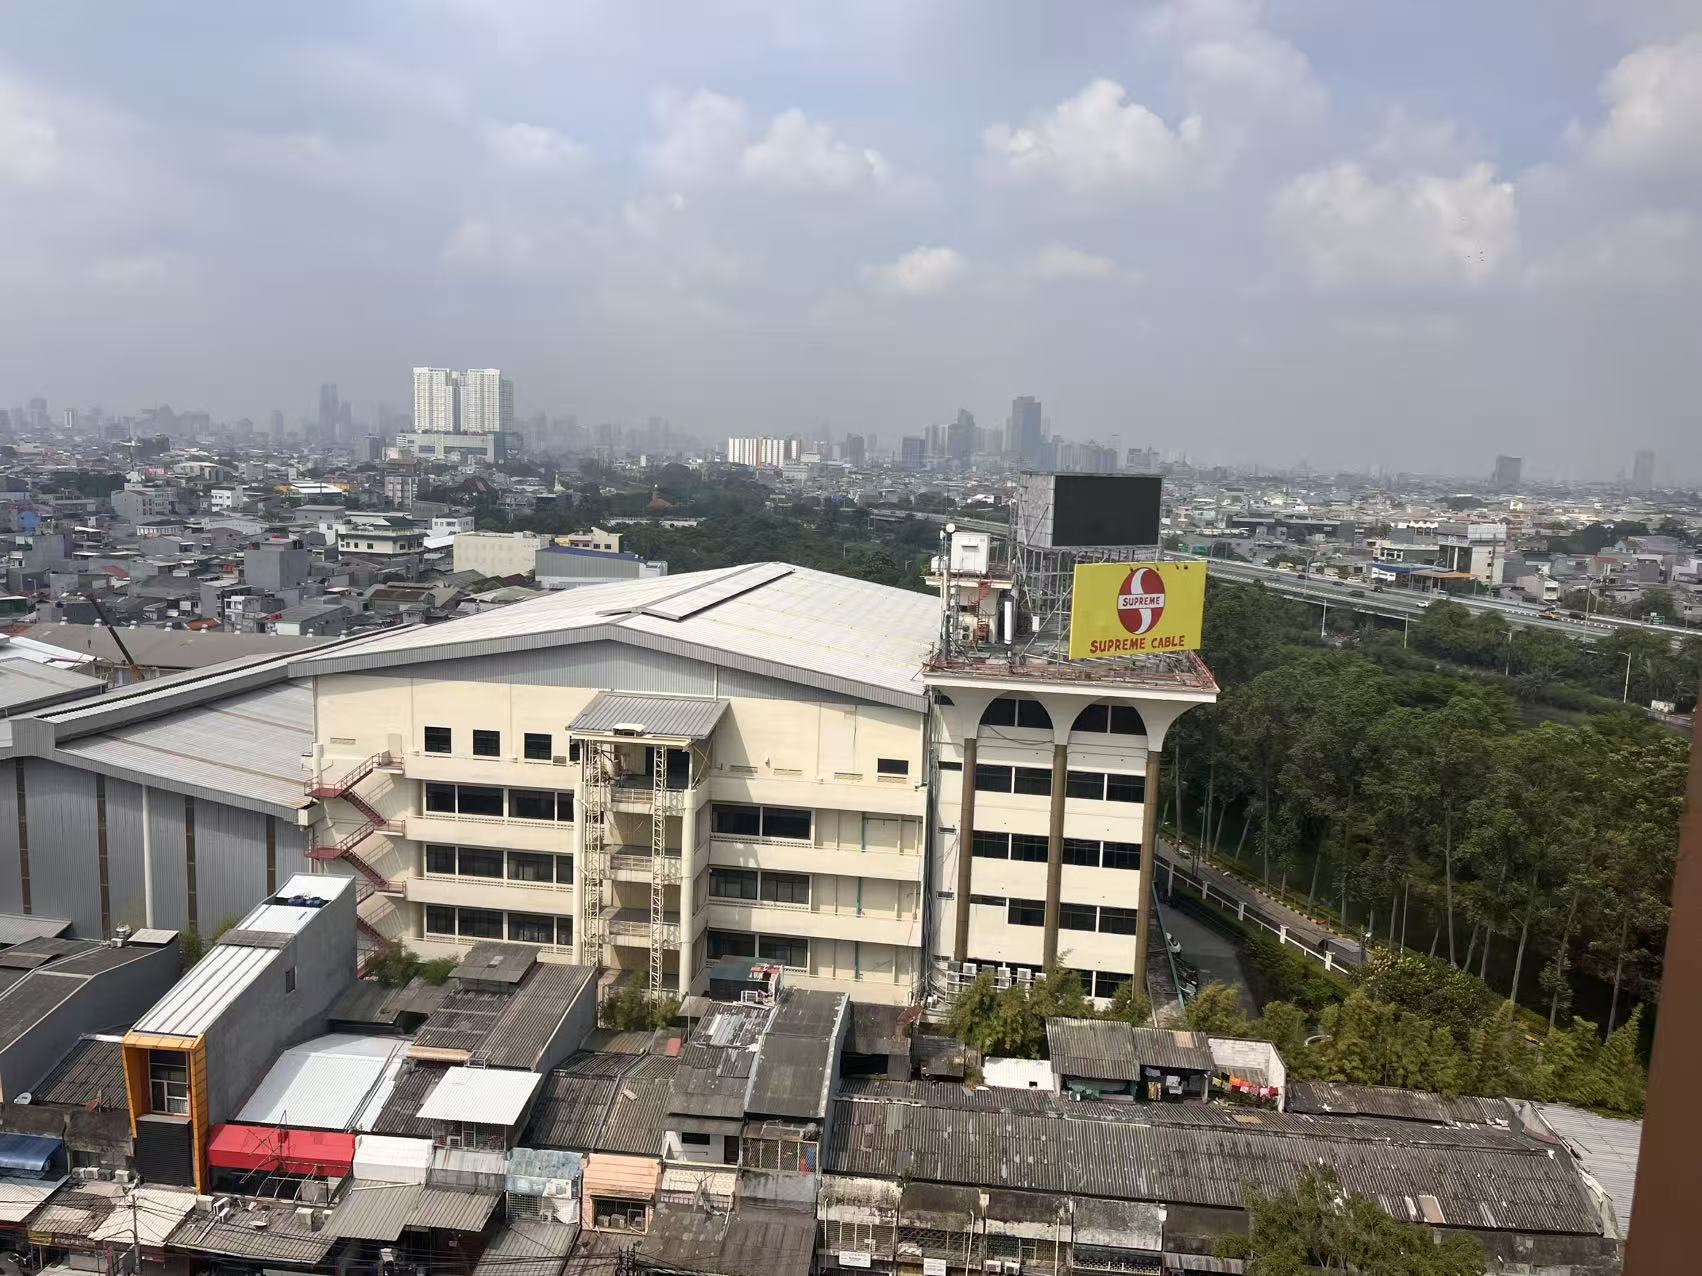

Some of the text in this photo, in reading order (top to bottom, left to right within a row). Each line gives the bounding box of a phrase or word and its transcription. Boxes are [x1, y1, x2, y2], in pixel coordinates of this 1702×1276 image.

[1122, 597, 1160, 607] SUPREME
[1089, 635, 1185, 654] SUPREME CABLE
